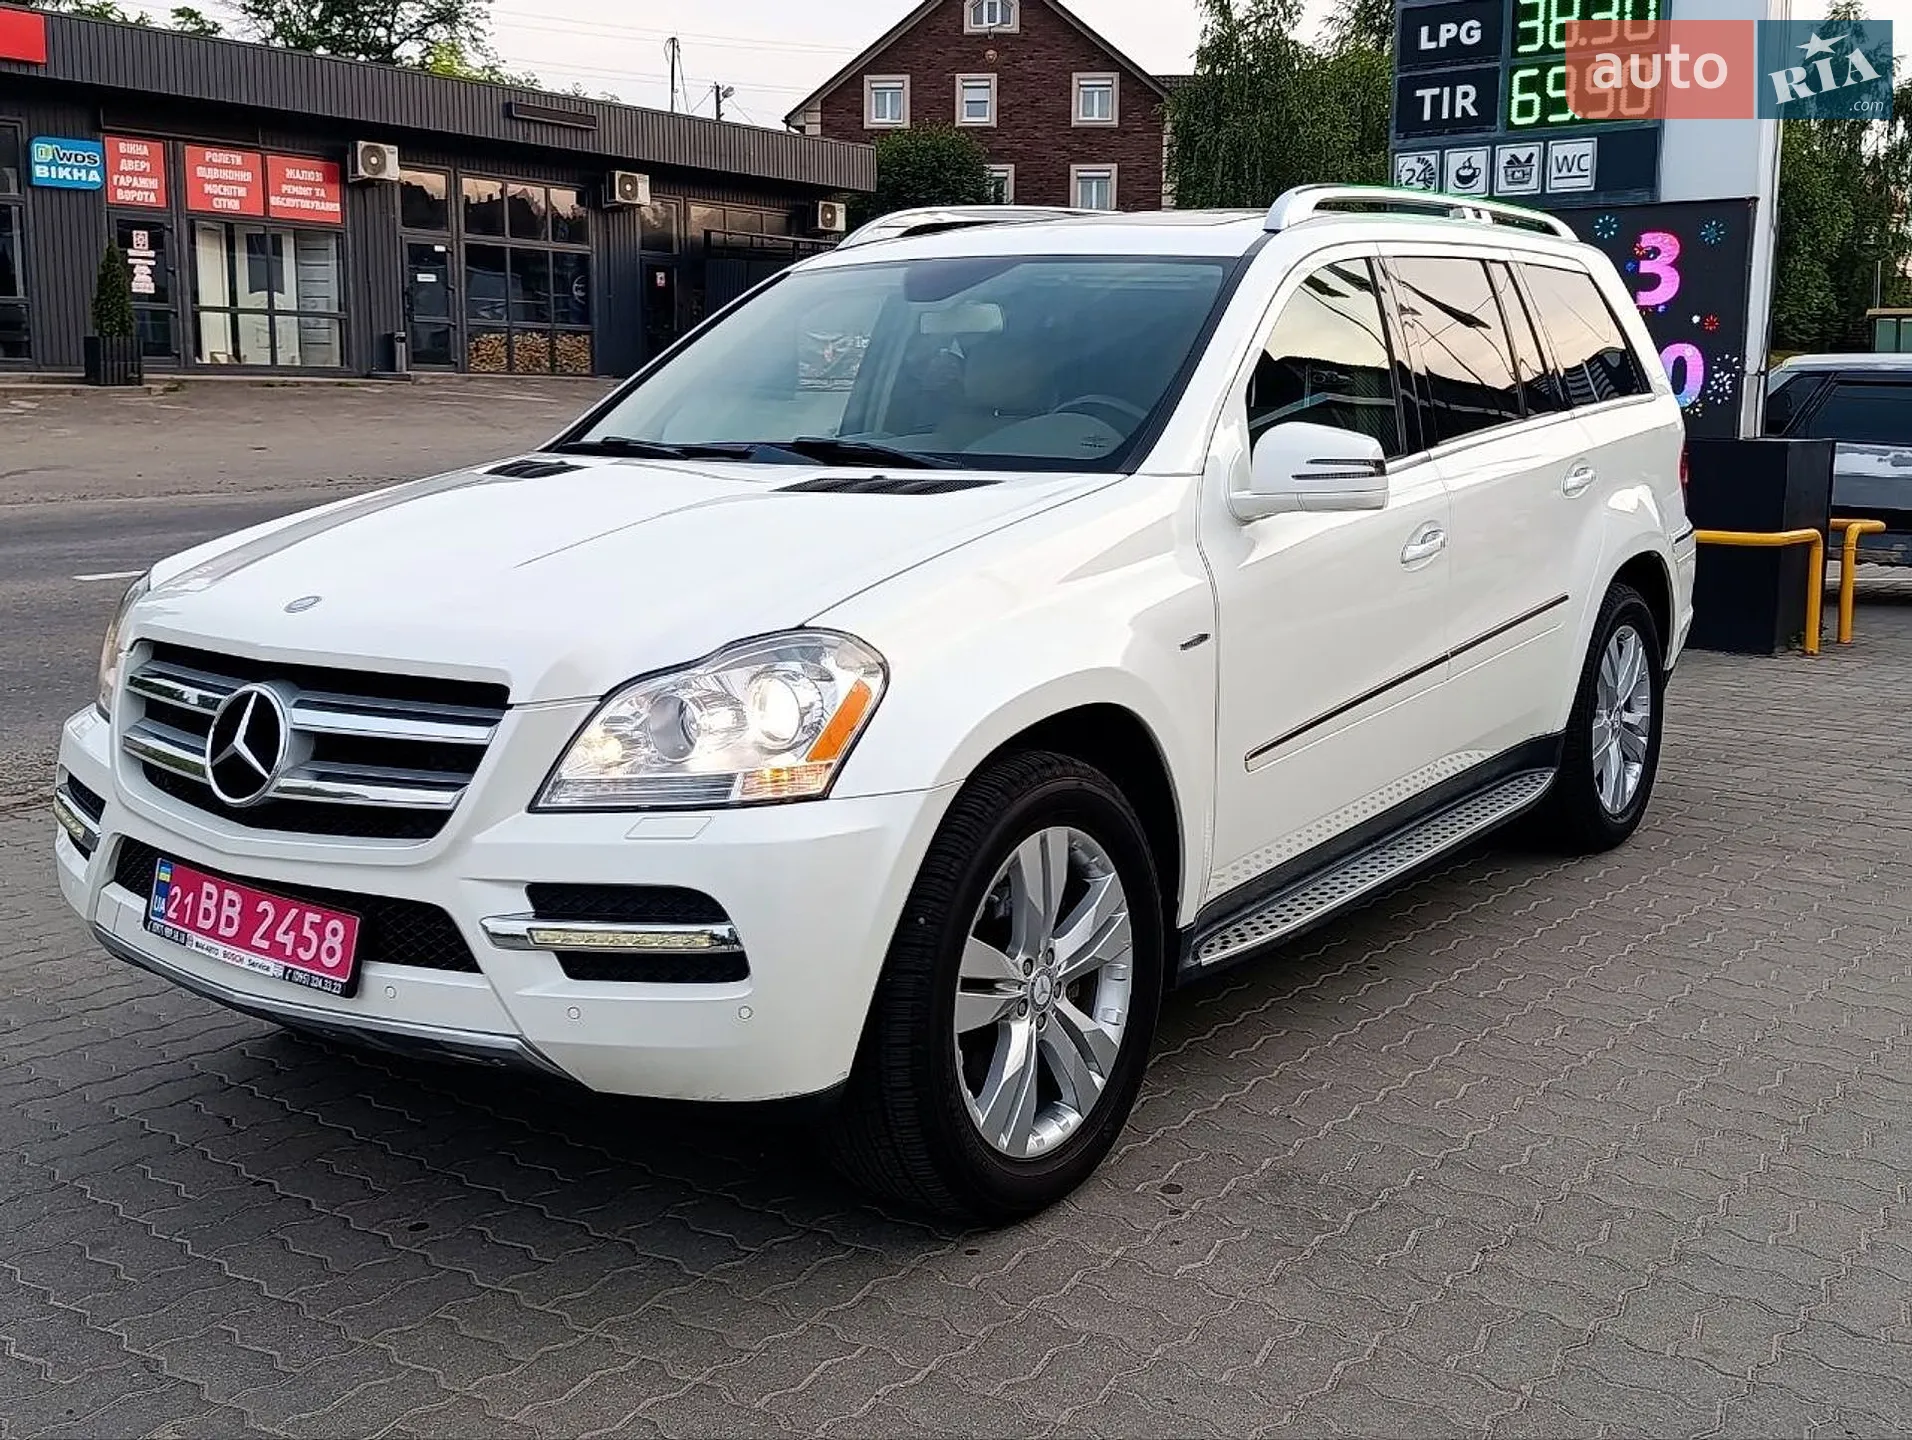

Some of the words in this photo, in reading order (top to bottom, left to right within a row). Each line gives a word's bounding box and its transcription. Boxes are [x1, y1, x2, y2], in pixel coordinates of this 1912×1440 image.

[1420, 19, 1482, 50] LPG
[1415, 84, 1478, 121] TIR
[53, 146, 99, 166] WDS
[119, 142, 149, 156] ВІКНА
[119, 159, 151, 172] ДВЕРІ
[204, 151, 243, 165] РОЛЕТИ
[1555, 153, 1589, 173] WC
[34, 165, 101, 182] ВІКНА
[112, 174, 159, 189] ГАРАЖНІ
[1405, 164, 1431, 186] 24
[116, 189, 157, 203] ВОРОТА
[281, 184, 313, 196] РЕМОНТ
[314, 187, 326, 198] ТА
[153, 895, 166, 913] UA
[251, 900, 345, 968] 2458
